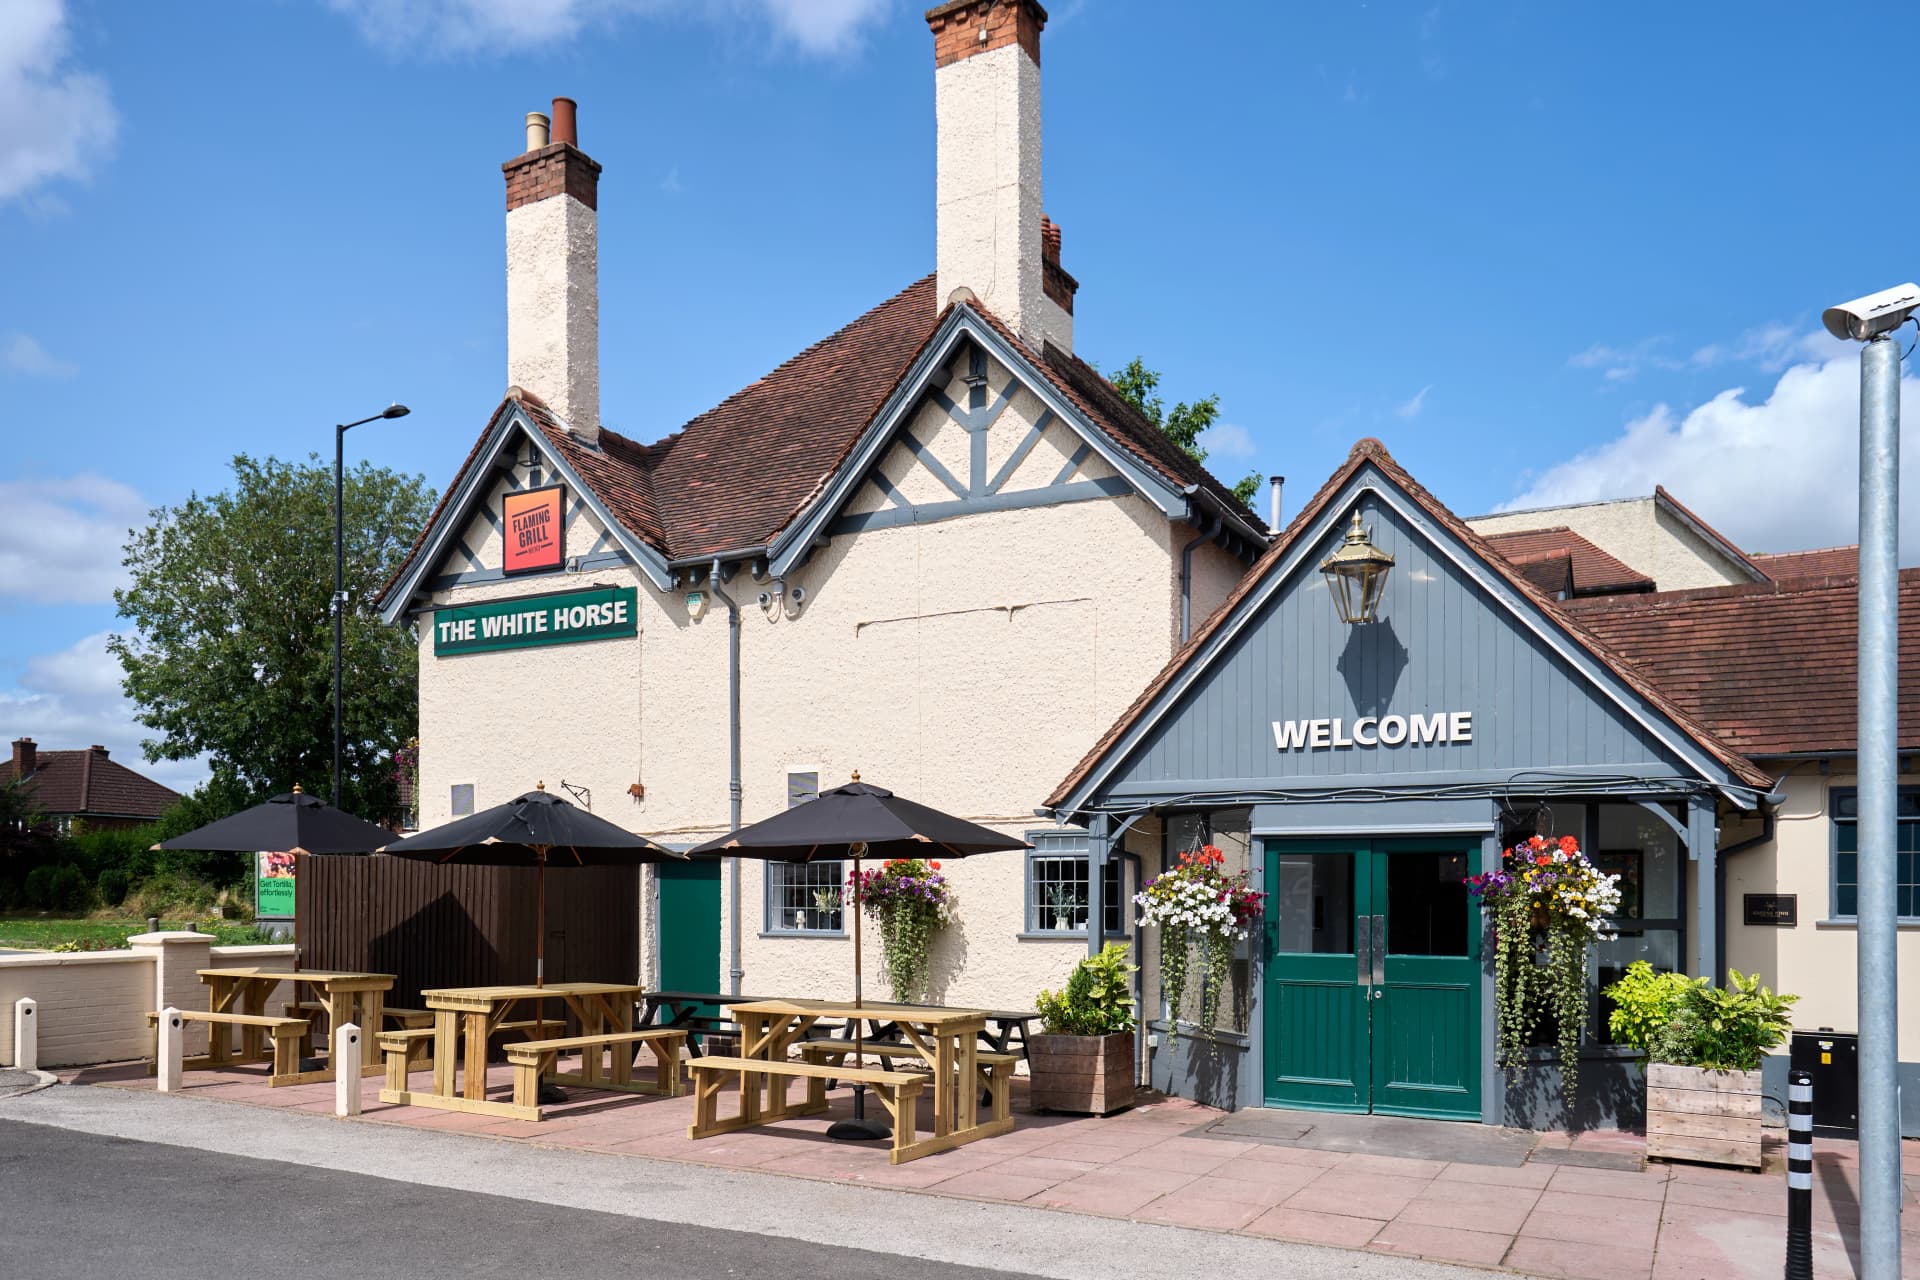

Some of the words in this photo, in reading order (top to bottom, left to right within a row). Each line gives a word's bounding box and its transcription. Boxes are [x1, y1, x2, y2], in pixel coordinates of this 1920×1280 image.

[512, 509, 551, 534] FLAMING
[518, 525, 549, 548] GRILL
[438, 619, 476, 643] THE
[481, 609, 548, 639] WHITE
[554, 600, 628, 631] HORSE
[1271, 711, 1473, 749] WELCOME
[260, 880, 272, 888] Get
[260, 888, 293, 898] effortlessly
